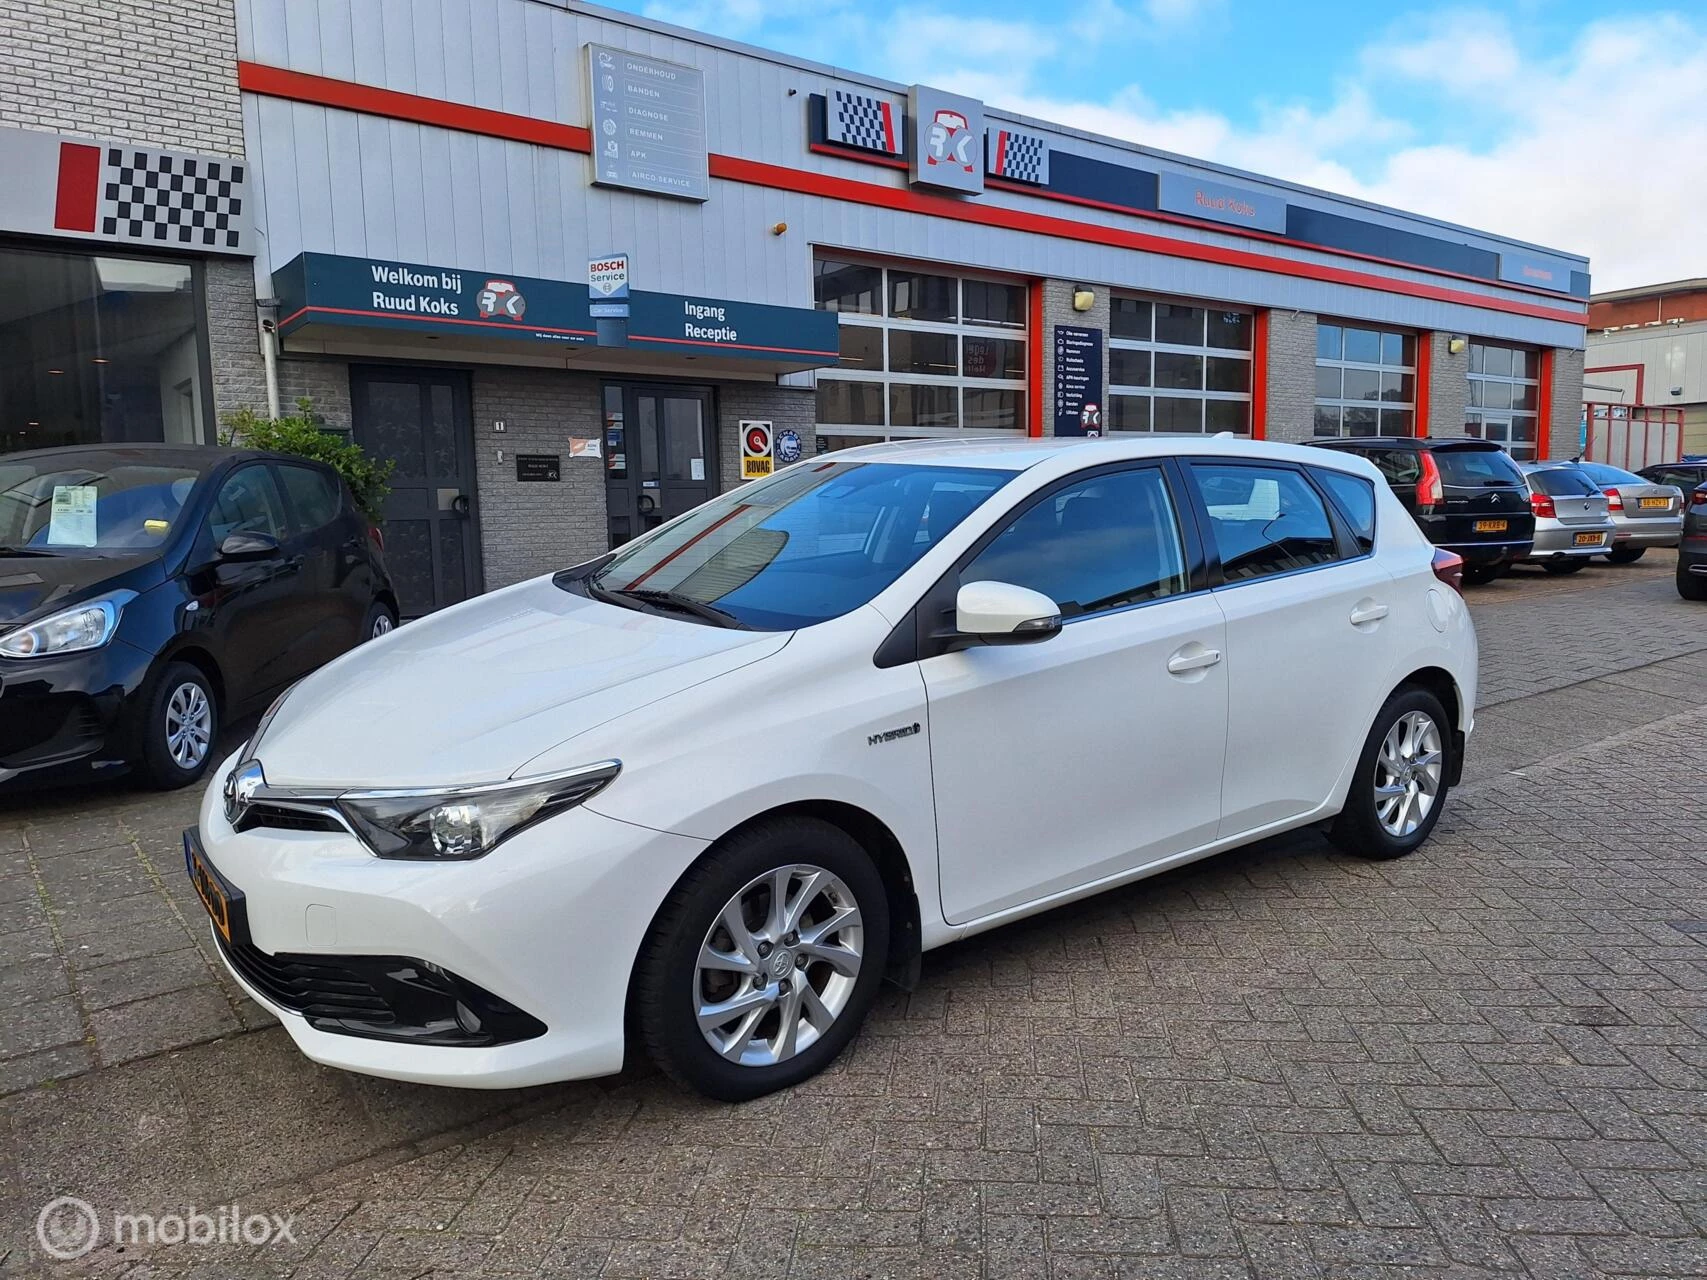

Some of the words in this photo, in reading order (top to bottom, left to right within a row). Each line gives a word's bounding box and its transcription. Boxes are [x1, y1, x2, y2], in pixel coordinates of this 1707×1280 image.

[626, 62, 676, 81] ONDERHOUD
[627, 84, 660, 98] BANDEN
[628, 106, 669, 122] DIAGNOSE
[629, 127, 664, 141] REMMEN
[630, 149, 647, 159] APK
[590, 260, 624, 273] BOSCH
[371, 265, 439, 288] Welkom
[441, 273, 463, 295] bij
[590, 272, 625, 282] Service
[372, 291, 416, 313] Ruud
[419, 296, 459, 316] Koks
[684, 301, 726, 322] Ingang
[684, 323, 738, 343] Receptie
[746, 460, 770, 474] BOVAG
[867, 725, 914, 746] HYBRID
